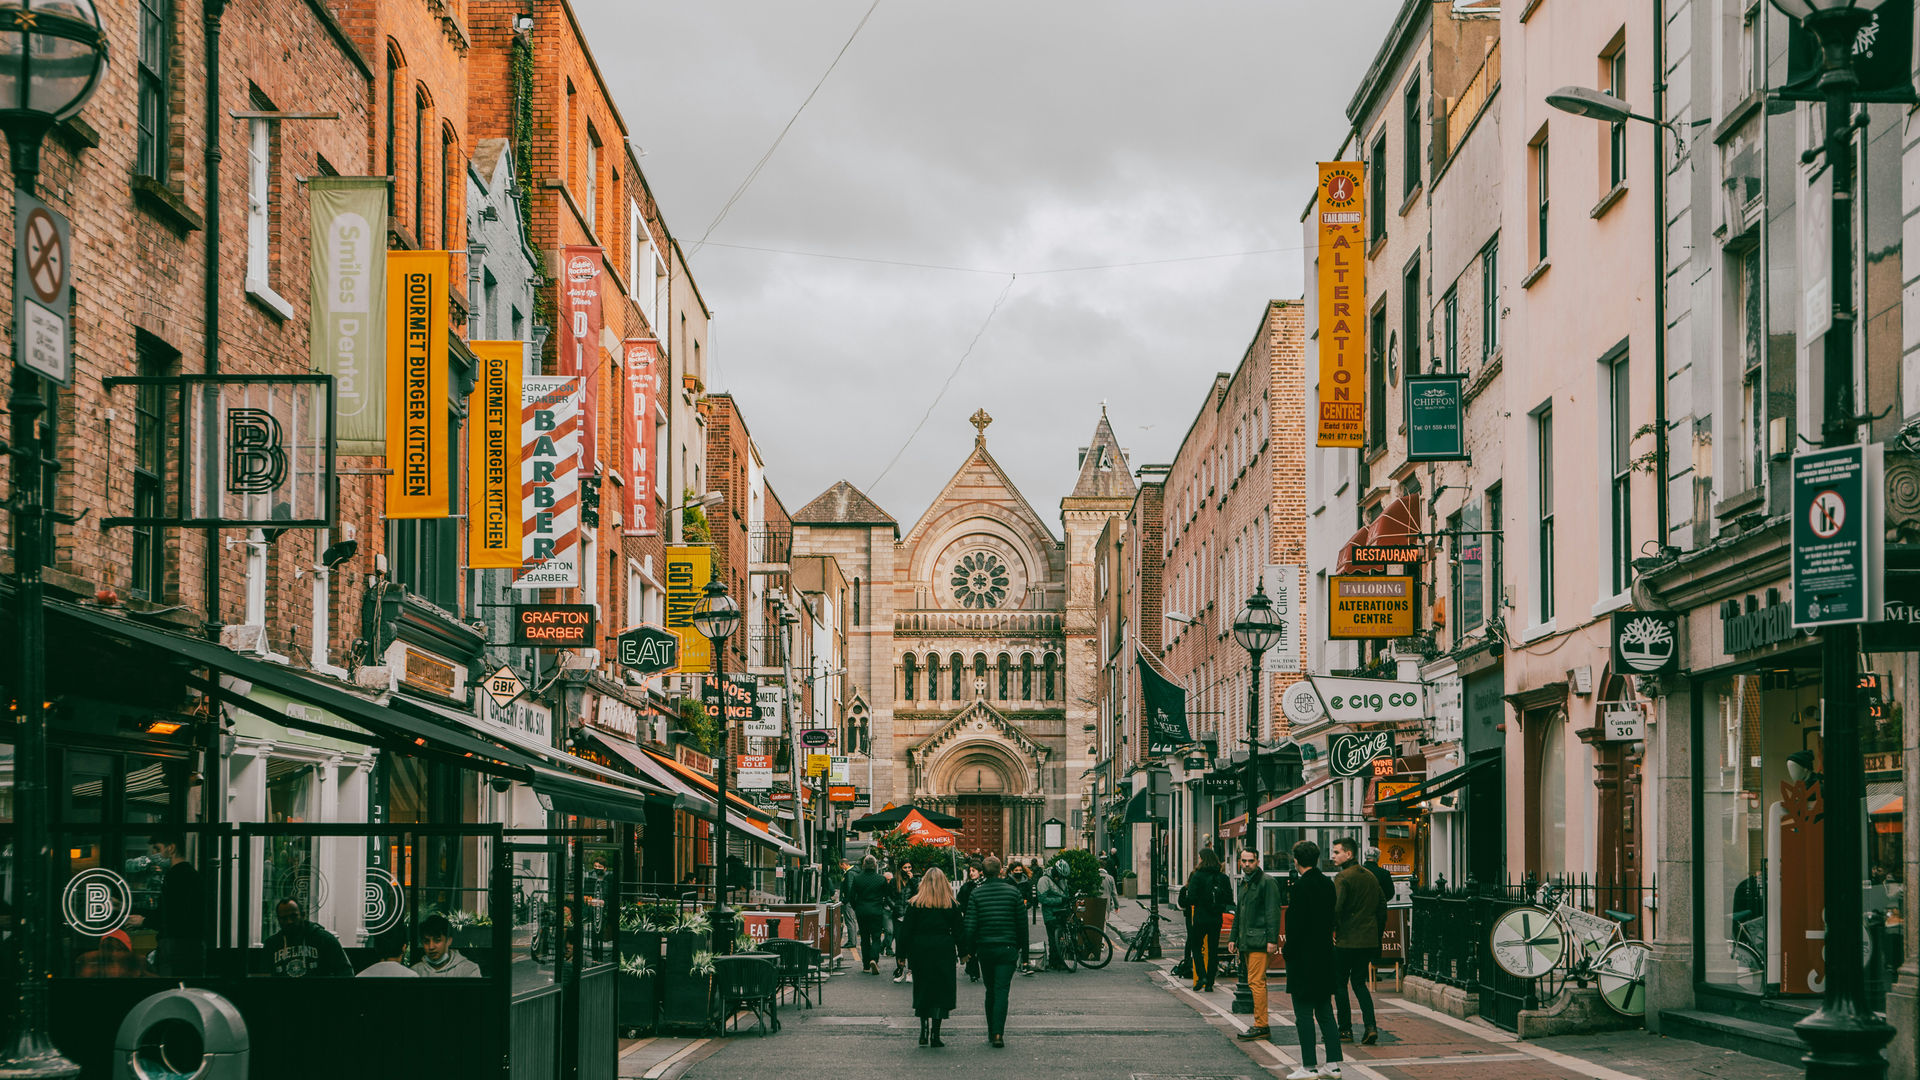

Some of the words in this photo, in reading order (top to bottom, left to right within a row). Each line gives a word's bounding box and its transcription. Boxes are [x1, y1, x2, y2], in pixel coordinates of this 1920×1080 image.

[1322, 170, 1360, 187] ALTERATION
[1326, 197, 1355, 208] CENTRE
[1323, 213, 1360, 223] TAILORING
[339, 225, 361, 304] Smiles
[409, 273, 426, 352] GOURMET
[1332, 235, 1351, 401] ALTERATION
[338, 318, 360, 399] Dental
[409, 356, 426, 420] BURGER
[488, 359, 503, 426] GOURMET
[526, 384, 574, 392] GRAFTON
[527, 395, 569, 404] BARBER
[1413, 397, 1455, 407] CHIFFON
[1323, 403, 1361, 420] CENTRE
[226, 407, 288, 495] B
[488, 429, 503, 485] BURGER
[409, 425, 426, 497] KITCHEN
[632, 392, 647, 528] DINER
[532, 409, 558, 560] BARBER
[488, 489, 503, 549] KITCHEN
[527, 573, 569, 582] BARBER
[668, 562, 702, 628] GOTHAM
[1343, 584, 1402, 594] TAILORING
[1277, 586, 1288, 616] Clinic
[1338, 600, 1409, 612] ALTERATIONS
[522, 611, 589, 624] GRAFTON
[1353, 613, 1393, 624] CENTRE
[526, 626, 584, 639] BARBER
[1277, 618, 1290, 653] Trinity
[622, 637, 673, 665] EAT
[492, 680, 515, 693] GBK
[728, 674, 756, 683] WINES
[1330, 695, 1344, 710] e
[1349, 693, 1383, 713] cig
[1388, 692, 1418, 707] co
[1616, 727, 1633, 737] 30
[1331, 732, 1388, 776] Cave
[1374, 766, 1394, 776] BAR
[1382, 864, 1410, 872] TAILORING
[85, 883, 113, 922] B
[750, 923, 769, 937] EAT
[274, 945, 319, 962] IRELAND
